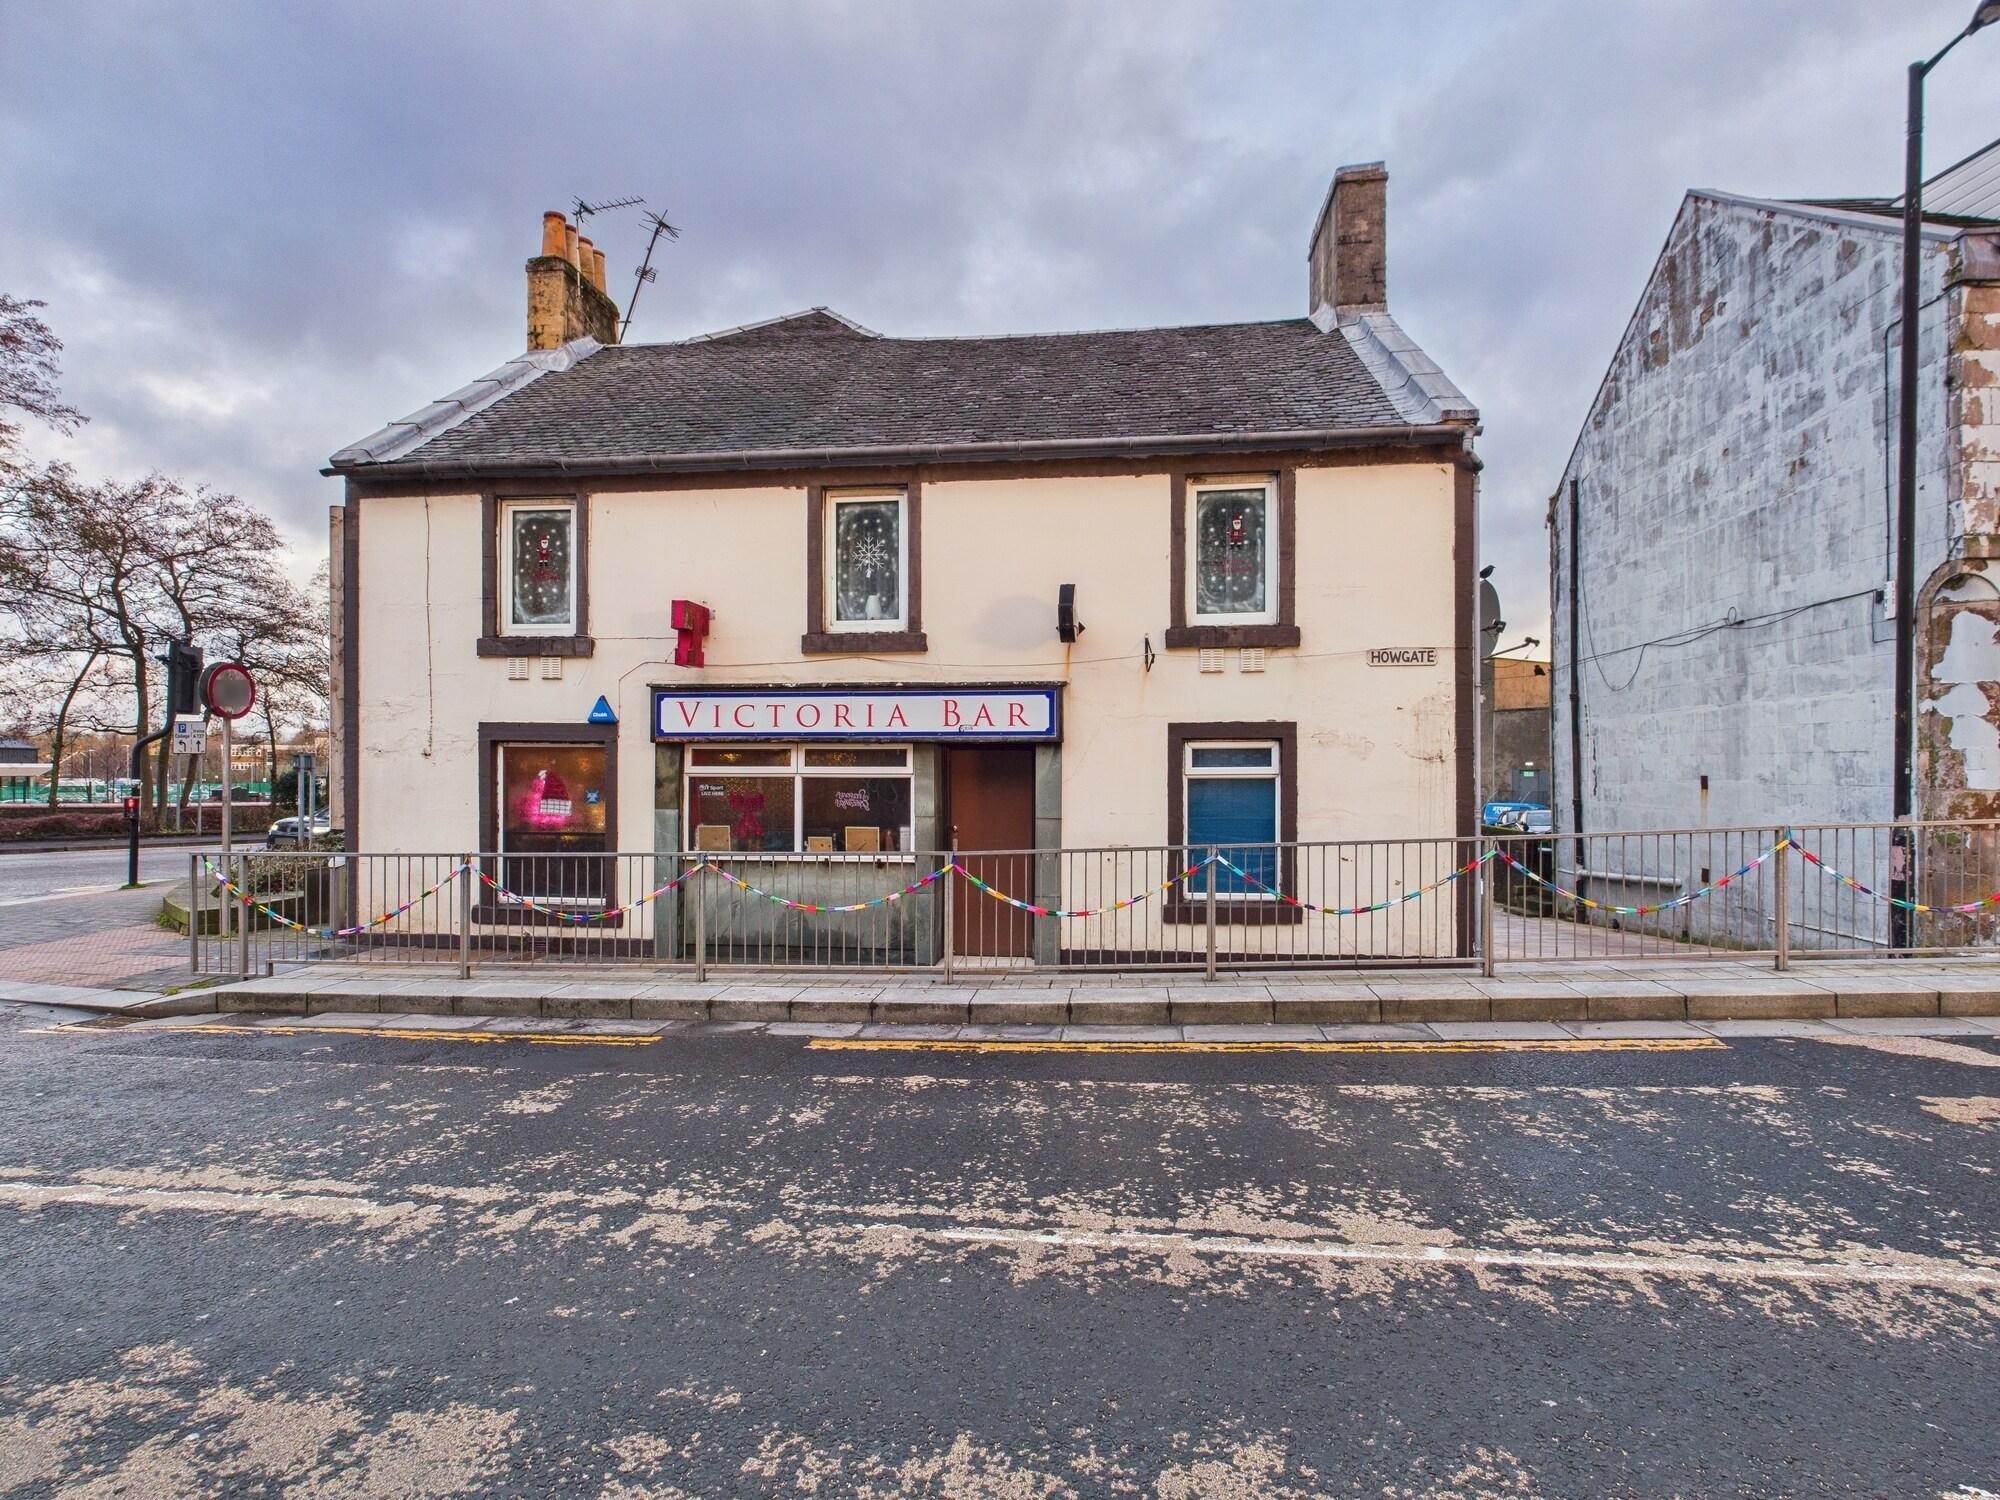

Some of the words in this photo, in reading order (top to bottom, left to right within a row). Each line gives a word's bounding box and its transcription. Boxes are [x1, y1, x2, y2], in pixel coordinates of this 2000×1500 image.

[1371, 650, 1435, 663] HOWGATE
[676, 700, 910, 728] VICTORIA
[942, 699, 1031, 727] BAR
